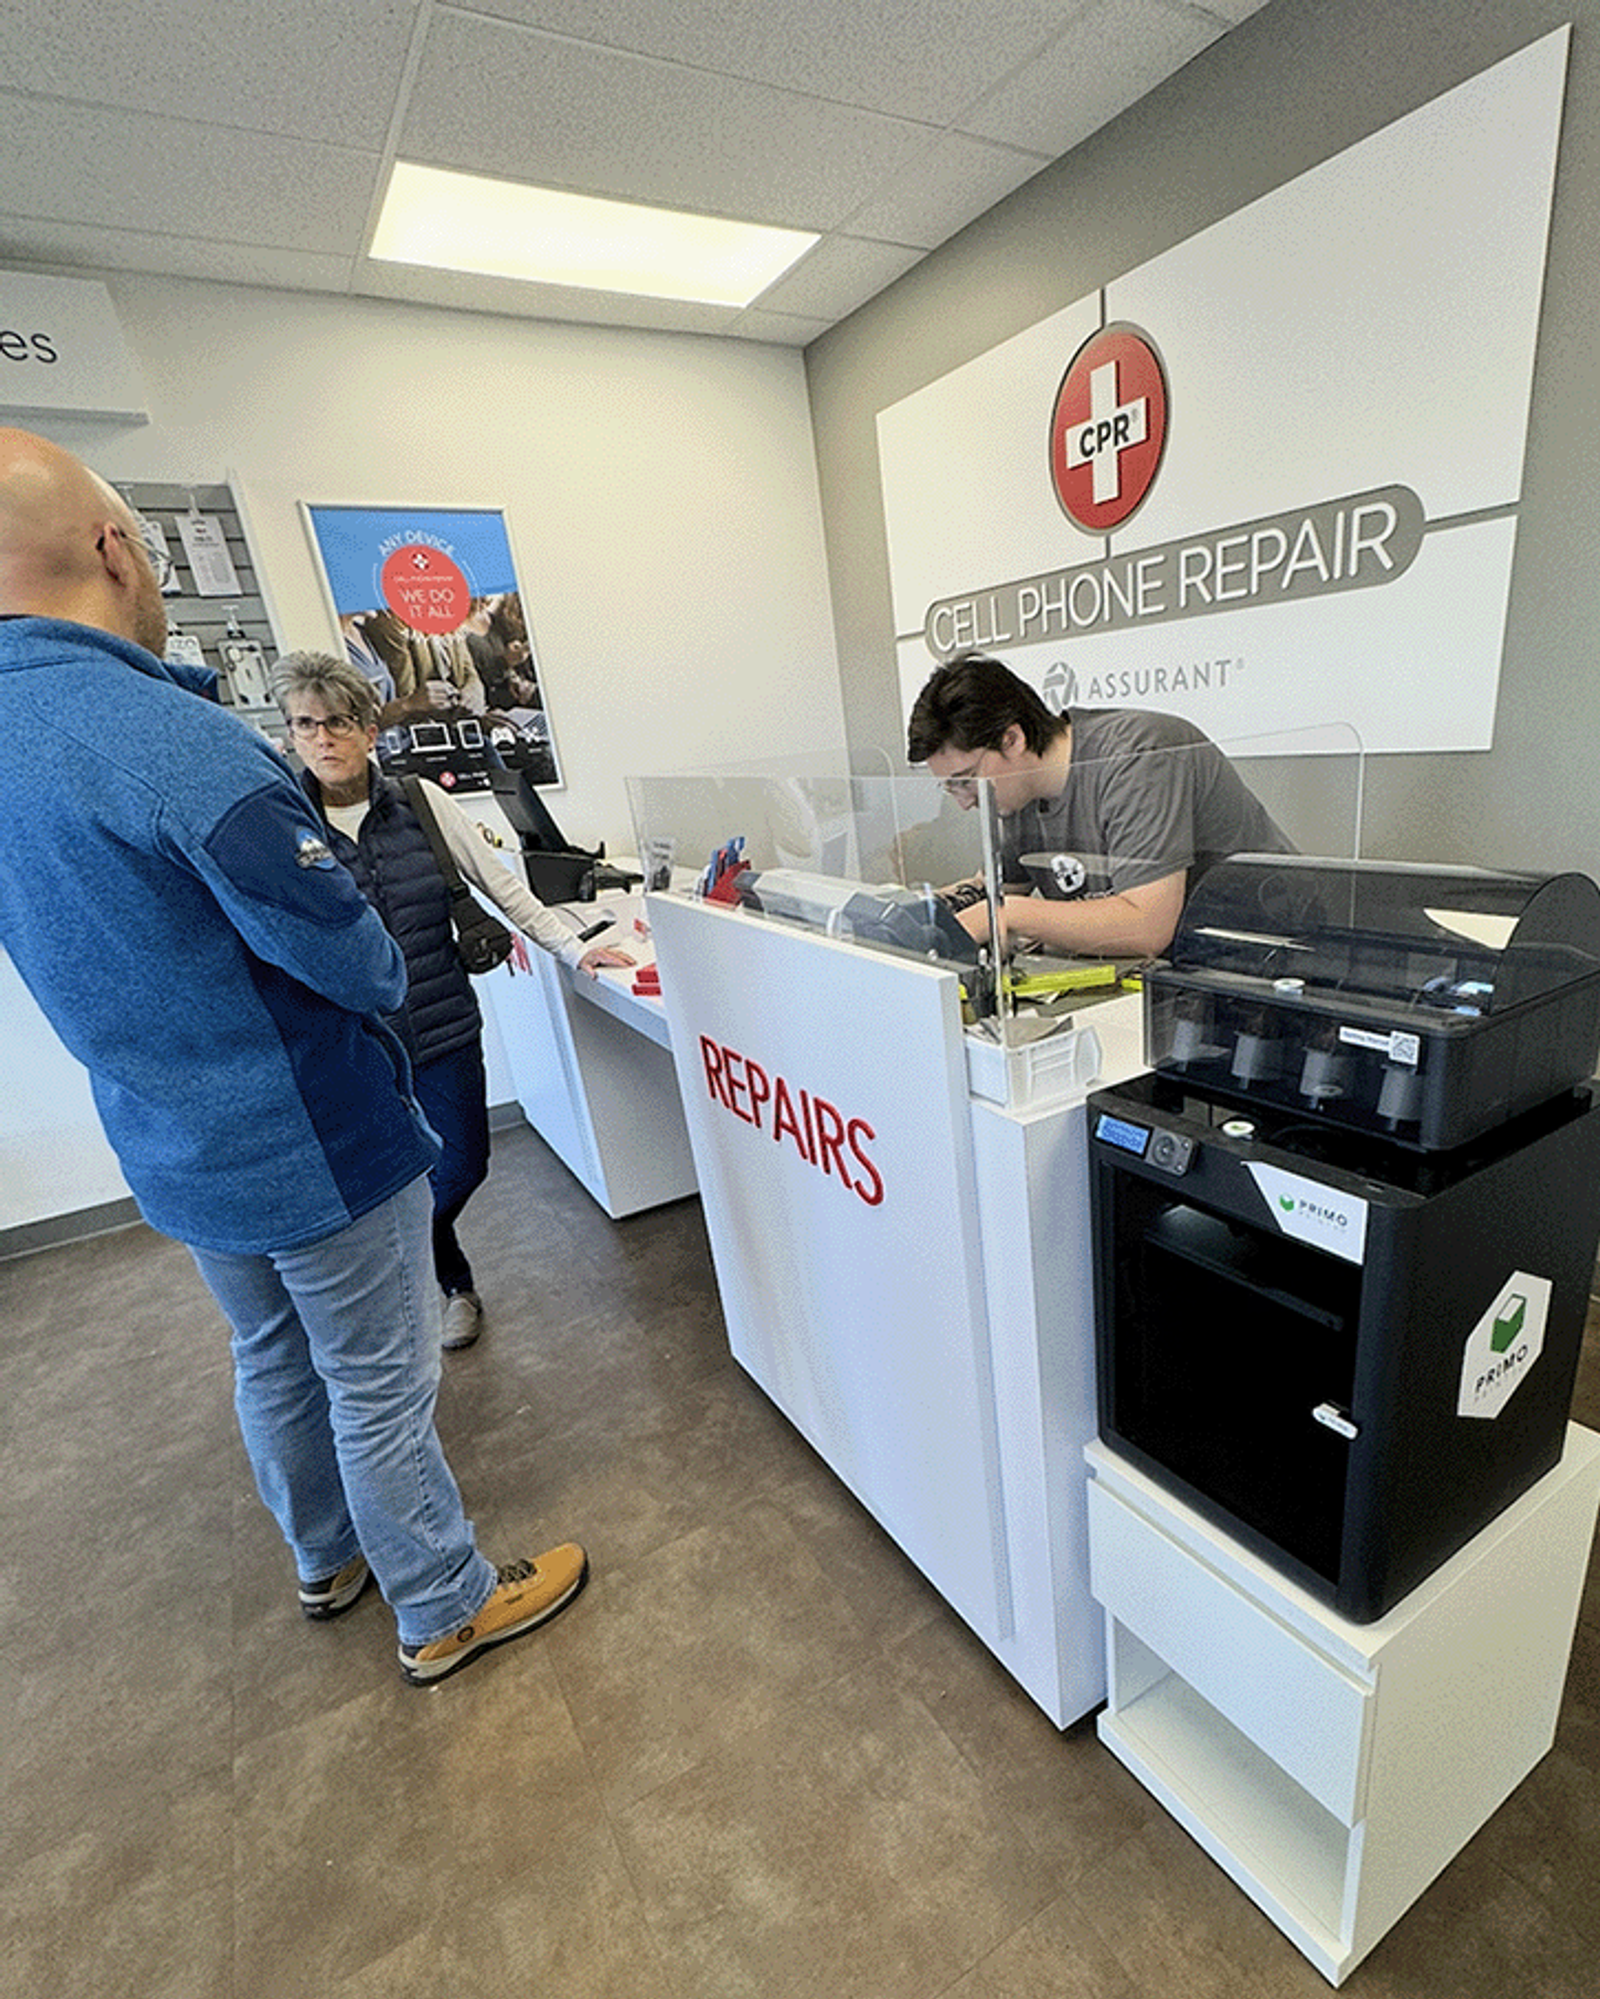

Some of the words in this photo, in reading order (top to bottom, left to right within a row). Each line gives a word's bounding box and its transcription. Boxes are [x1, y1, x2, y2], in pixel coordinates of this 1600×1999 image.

[379, 532, 402, 557] ANY
[404, 530, 455, 556] DEVICE
[931, 602, 1011, 653] CELL
[1018, 555, 1166, 637] PHONE
[1178, 501, 1398, 608] REPAIR
[398, 589, 425, 603] WE
[430, 588, 454, 603] DO
[409, 605, 421, 618] IT
[428, 605, 456, 618] ALL
[700, 1035, 885, 1206] REPAIRS
